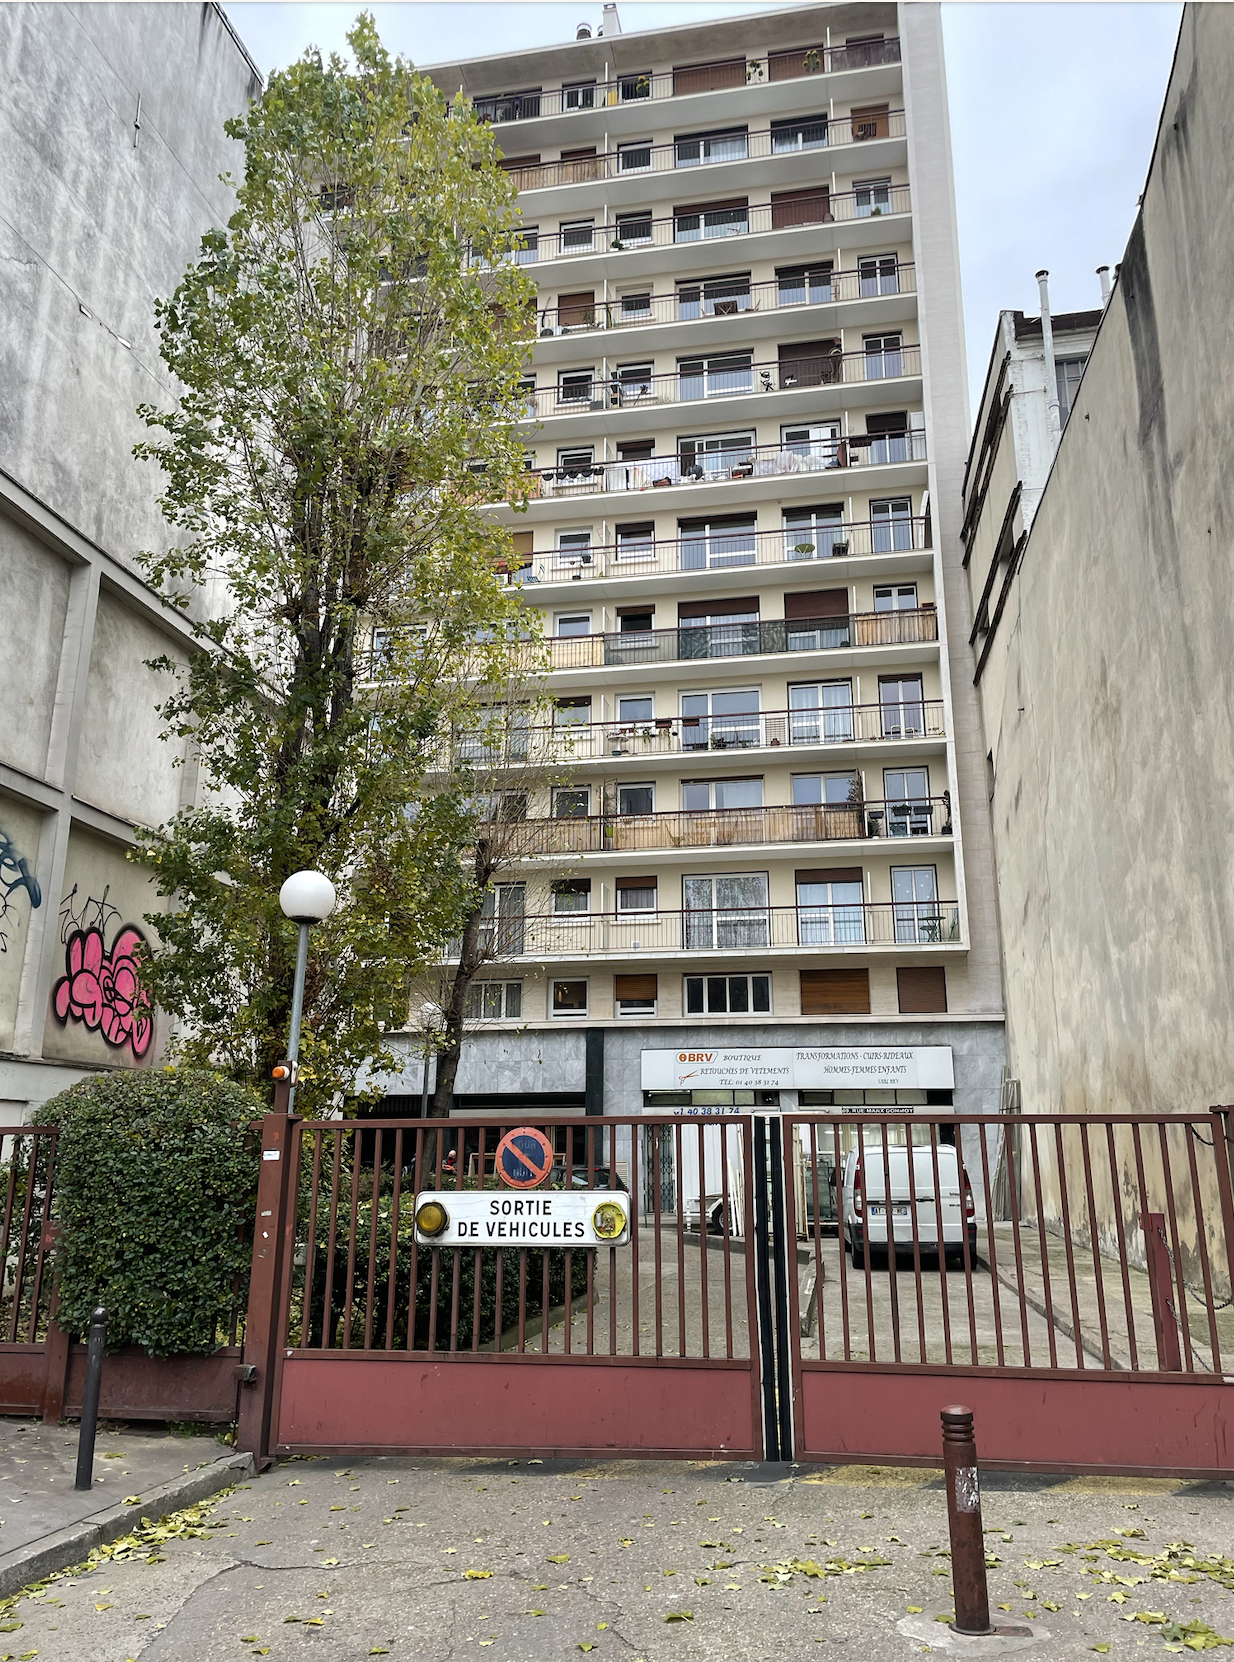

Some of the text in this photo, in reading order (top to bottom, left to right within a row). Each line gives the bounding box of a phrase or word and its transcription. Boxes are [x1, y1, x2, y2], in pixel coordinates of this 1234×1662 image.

[796, 1052, 859, 1061] TRANSFORMATIONS
[700, 1066, 790, 1075] RETOUCHES DE VETEMENTS
[687, 1107, 699, 1115] 40
[701, 1107, 712, 1115] 38
[715, 1107, 725, 1115] 31
[489, 1200, 552, 1216] SORTIE
[458, 1222, 585, 1238] DE VEHICULES
